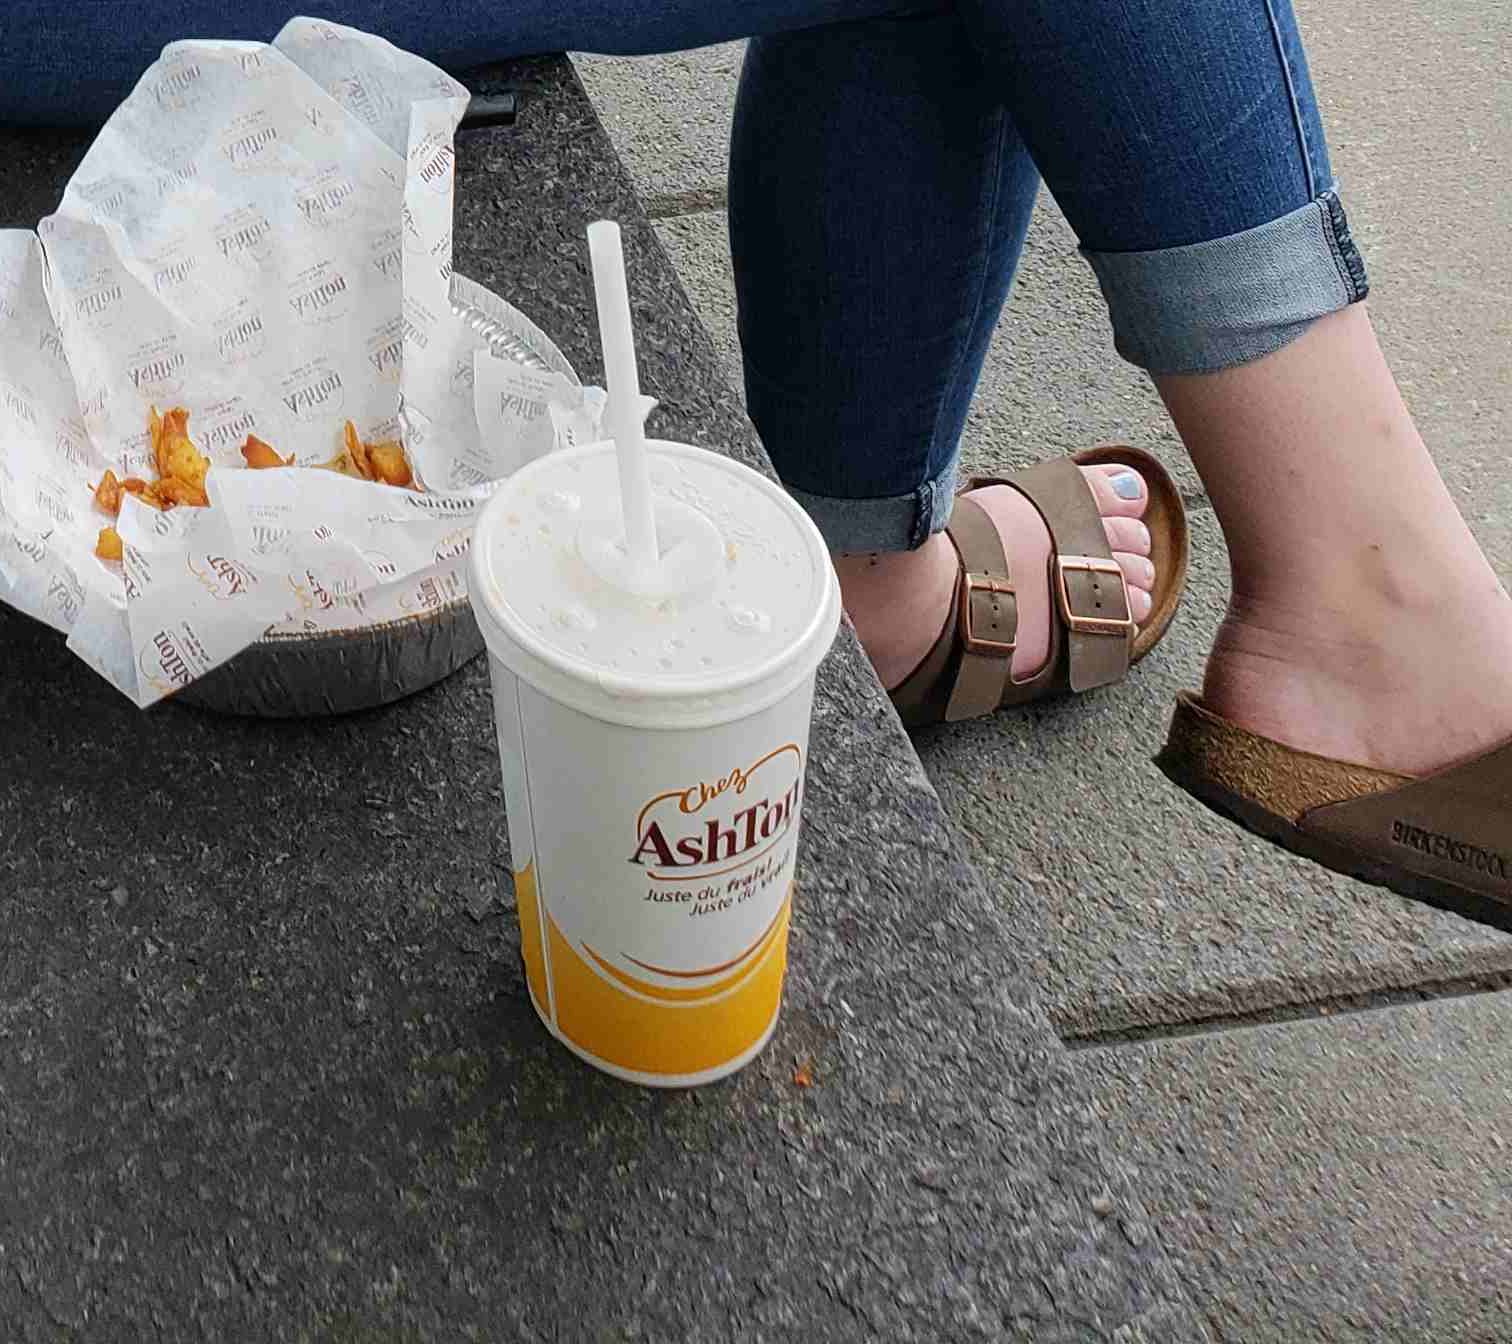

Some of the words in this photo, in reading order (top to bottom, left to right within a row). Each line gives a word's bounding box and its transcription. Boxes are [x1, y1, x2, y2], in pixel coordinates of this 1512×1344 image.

[679, 768, 747, 814] Chez
[644, 888, 692, 903] Juste
[698, 886, 720, 900] du
[689, 897, 733, 916] Juste
[738, 885, 757, 903] du
